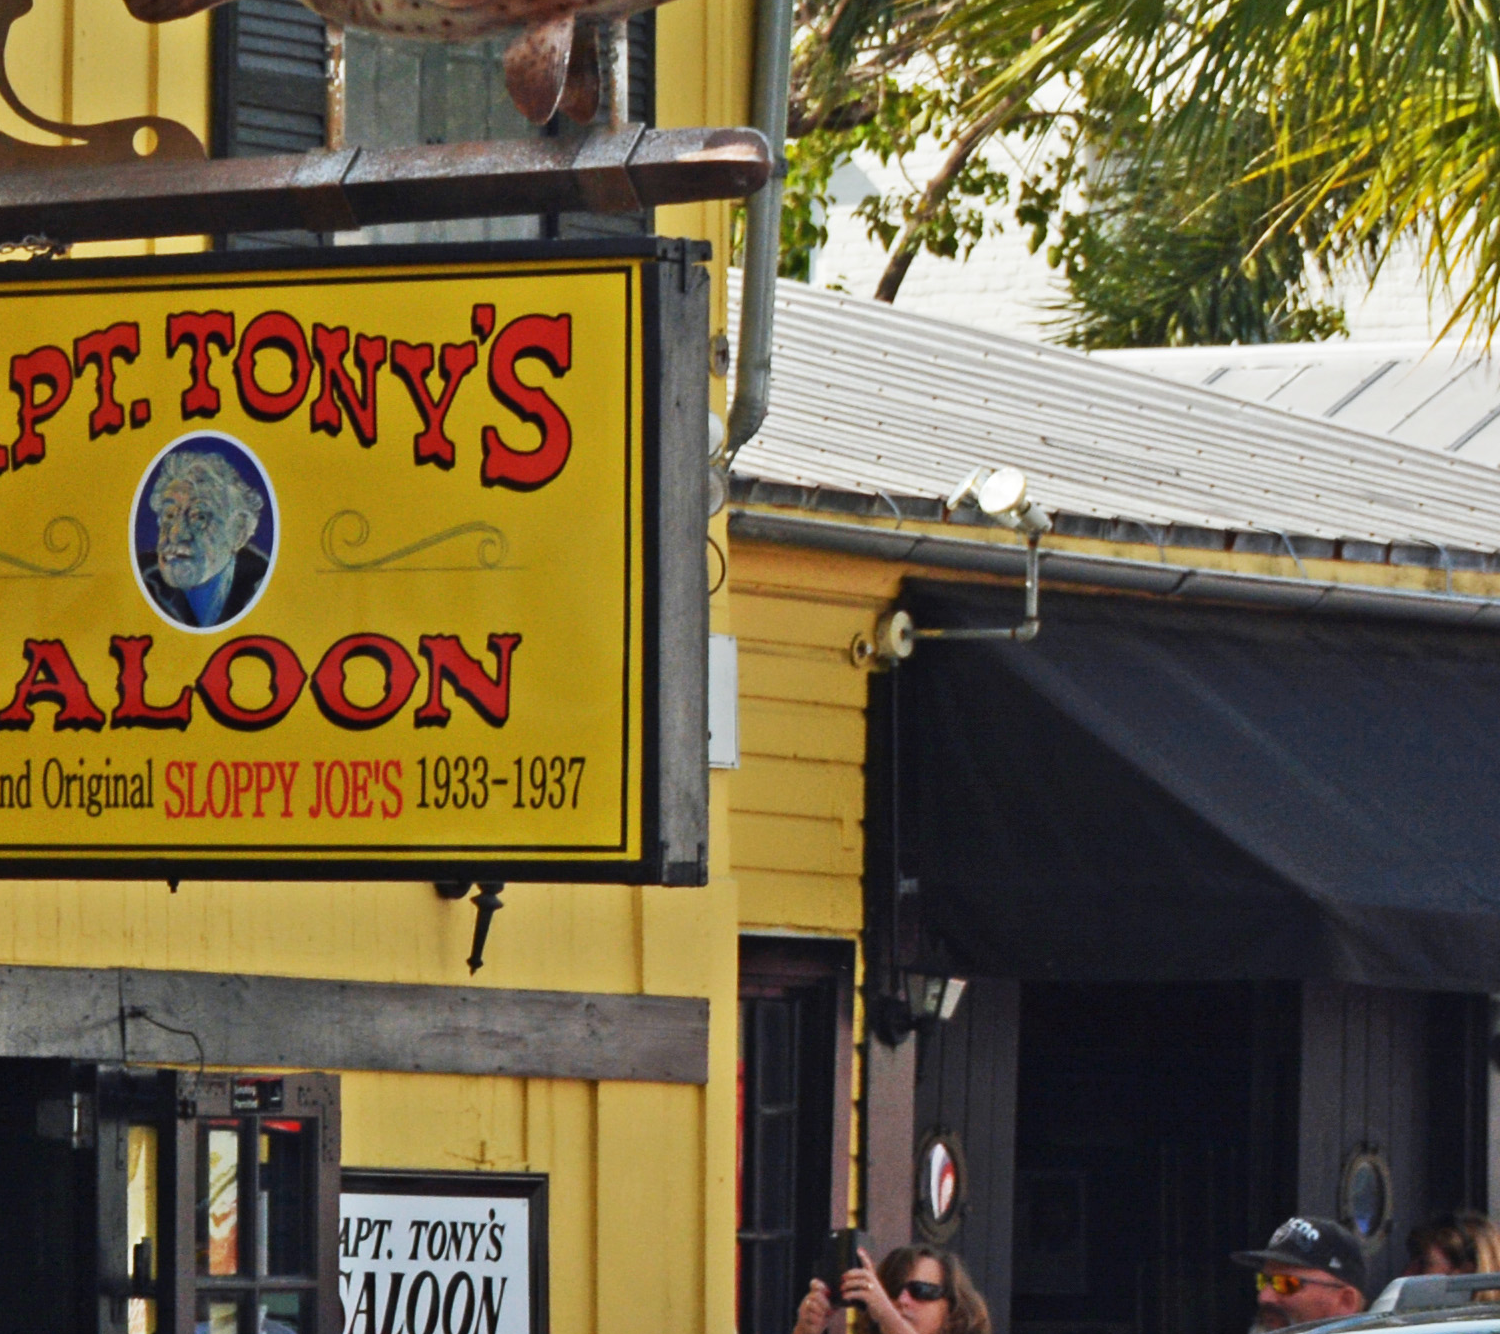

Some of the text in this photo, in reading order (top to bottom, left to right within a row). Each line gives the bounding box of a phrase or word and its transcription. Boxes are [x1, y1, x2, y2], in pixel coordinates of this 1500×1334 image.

[164, 303, 574, 492] TONY'S
[41, 757, 155, 820] Original
[164, 760, 299, 820] SLOPPY
[308, 759, 404, 820] JOE'S
[415, 755, 587, 810] 1933-1937
[339, 1207, 506, 1263] APT. TONY'S
